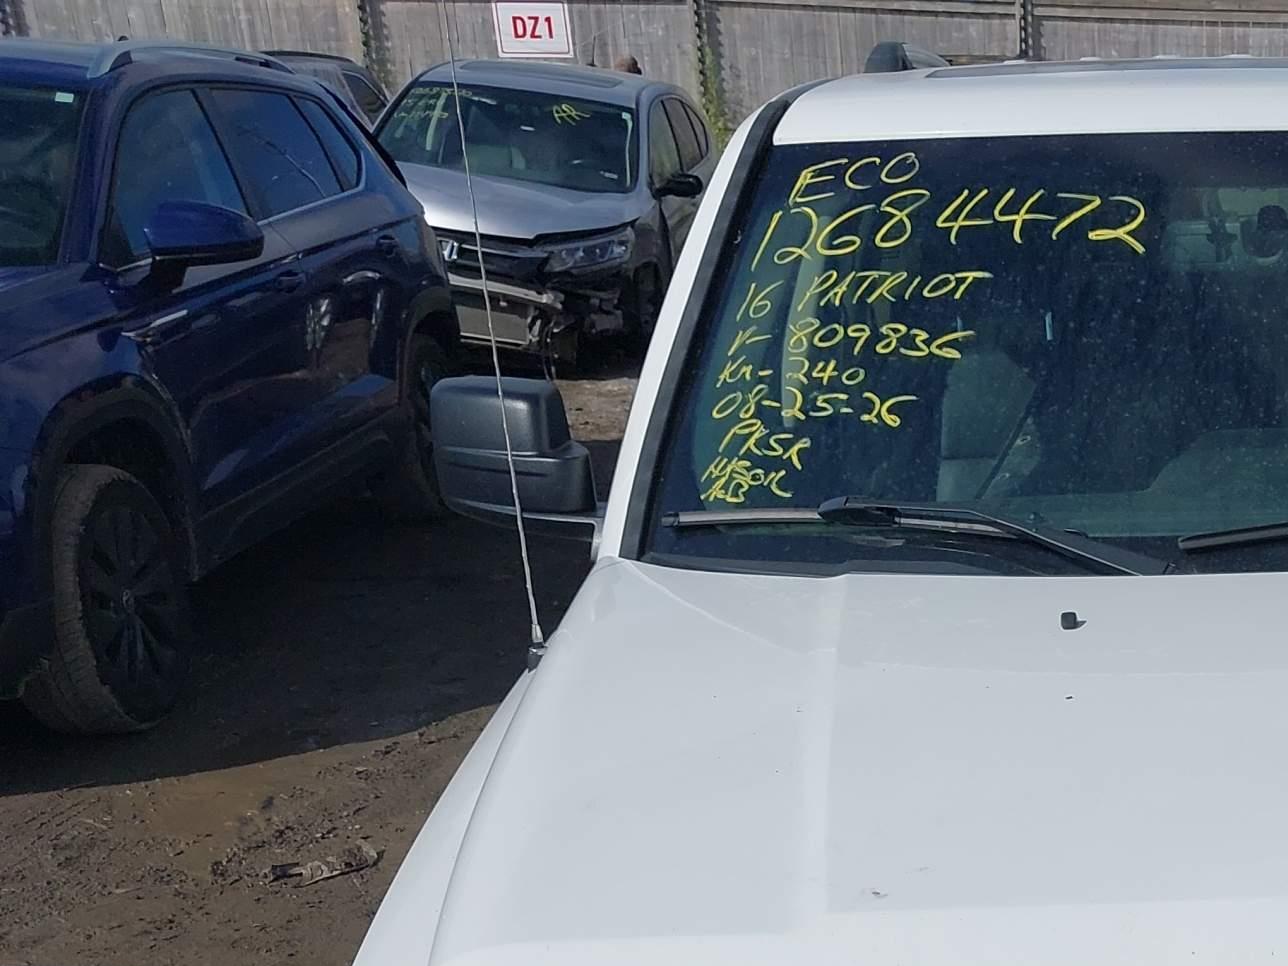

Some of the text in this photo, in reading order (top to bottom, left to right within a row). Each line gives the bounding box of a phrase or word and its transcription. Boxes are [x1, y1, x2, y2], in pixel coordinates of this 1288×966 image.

[511, 15, 554, 39] DZ1
[789, 152, 920, 208] ECO
[751, 189, 1146, 272] 12684472
[736, 270, 994, 322] 16 PATRIOT
[787, 317, 976, 359] 809836
[786, 356, 866, 385] 240
[711, 384, 921, 428] 08-25-26
